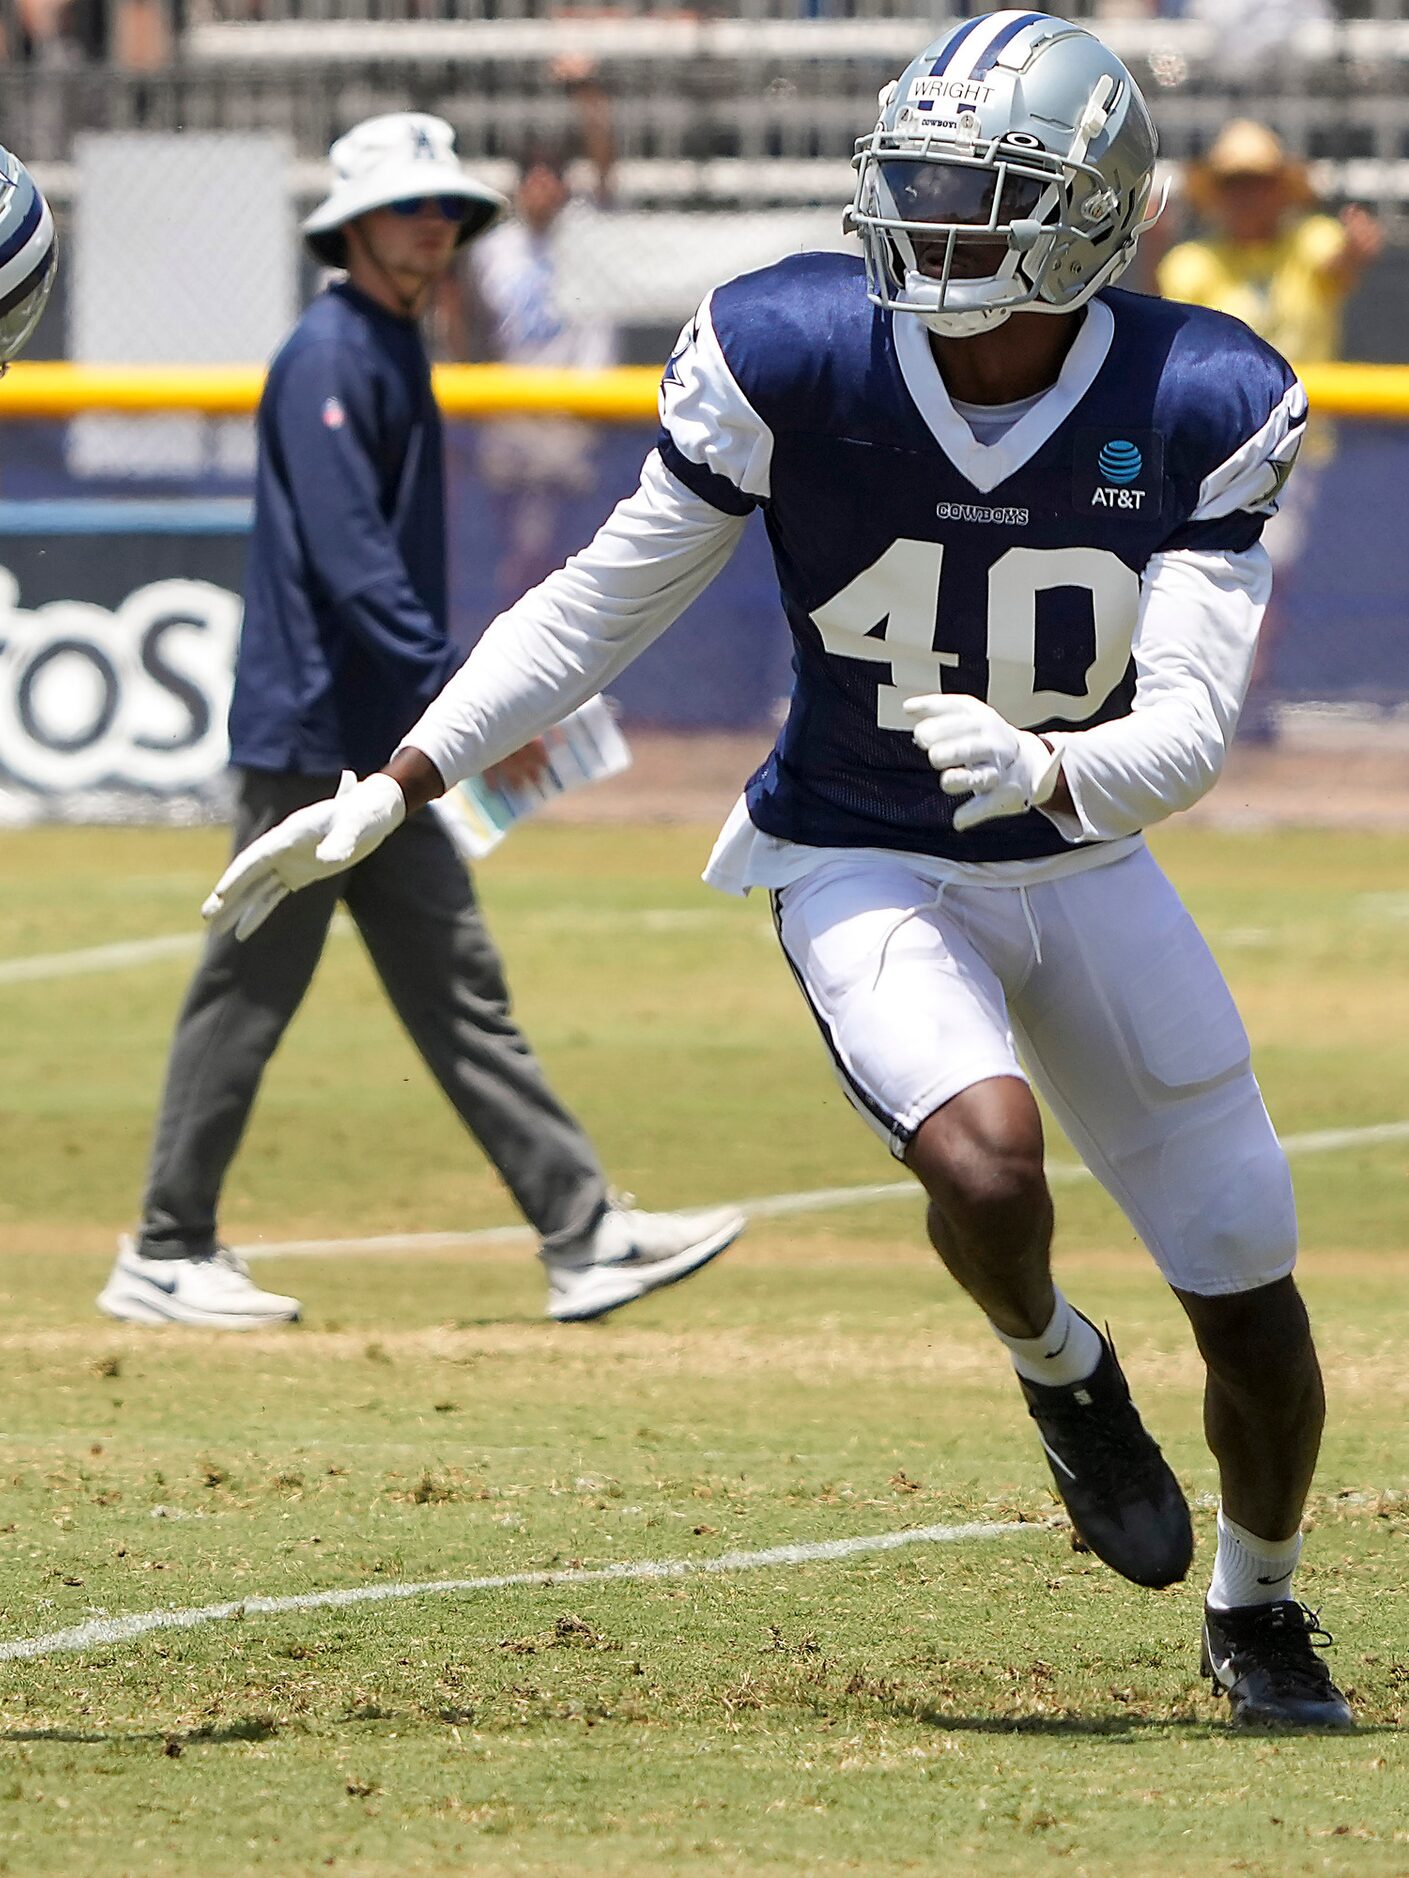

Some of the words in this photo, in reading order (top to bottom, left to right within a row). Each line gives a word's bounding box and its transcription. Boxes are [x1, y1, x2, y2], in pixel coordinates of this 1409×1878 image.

[914, 80, 995, 103] WRIGHT
[1091, 487, 1146, 510] AT&T
[936, 502, 1030, 526] COWBOYS
[808, 538, 1141, 731] 40
